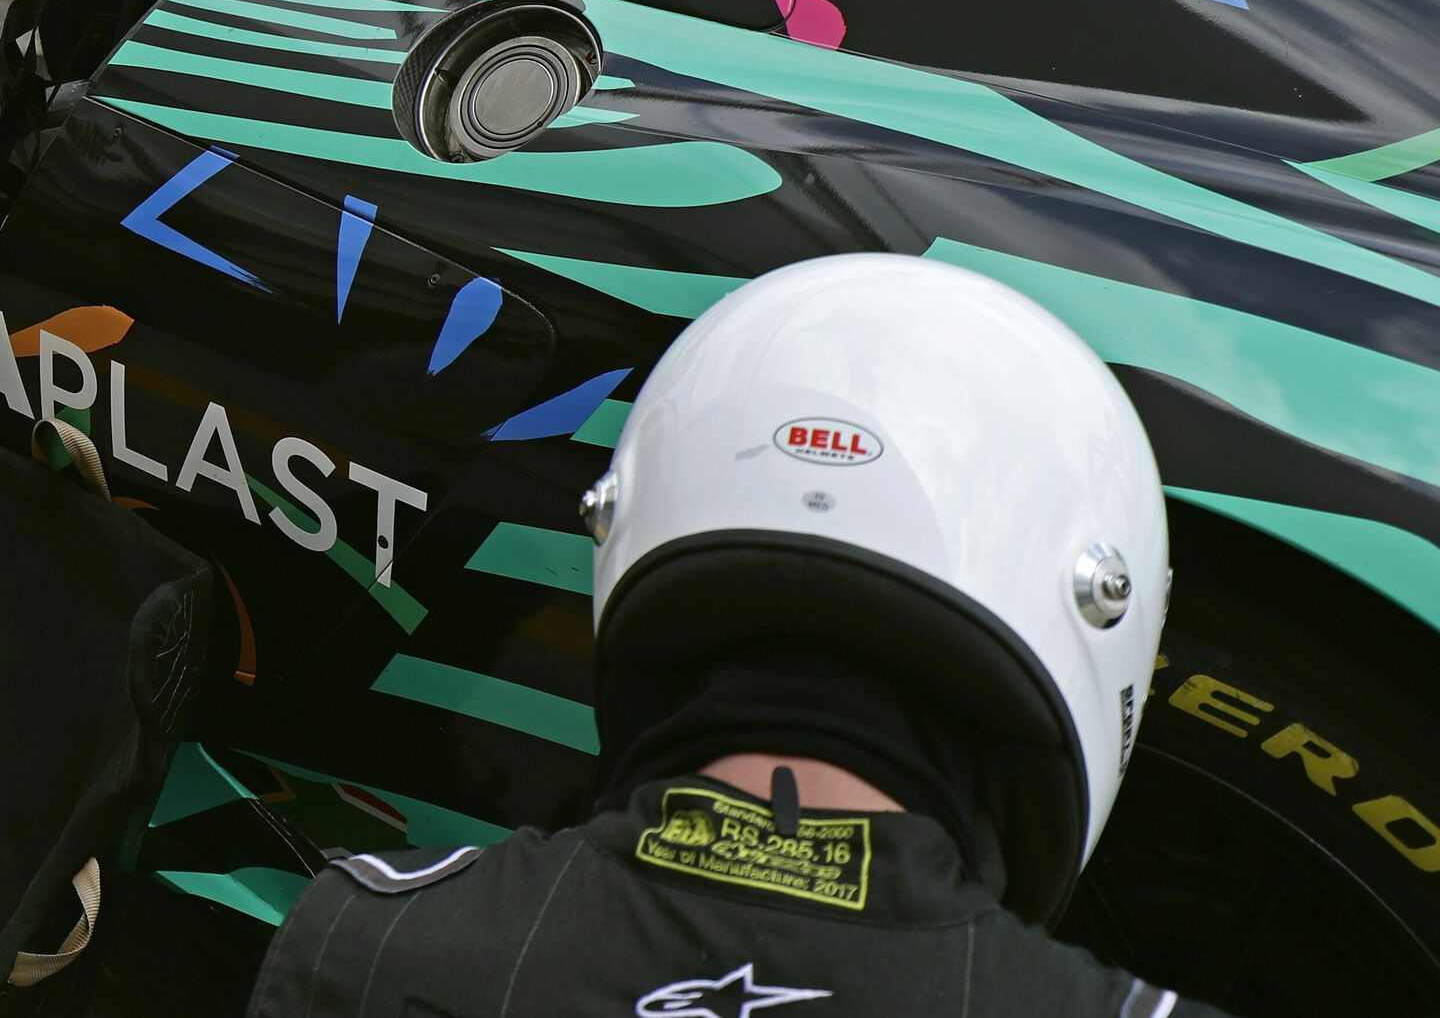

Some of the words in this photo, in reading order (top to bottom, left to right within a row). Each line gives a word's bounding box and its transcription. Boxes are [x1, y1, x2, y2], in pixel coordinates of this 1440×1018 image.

[788, 426, 867, 455] BELL
[1152, 654, 1440, 873] ERO
[647, 838, 677, 861] Year
[679, 850, 698, 865] of
[813, 879, 859, 901] 2017
